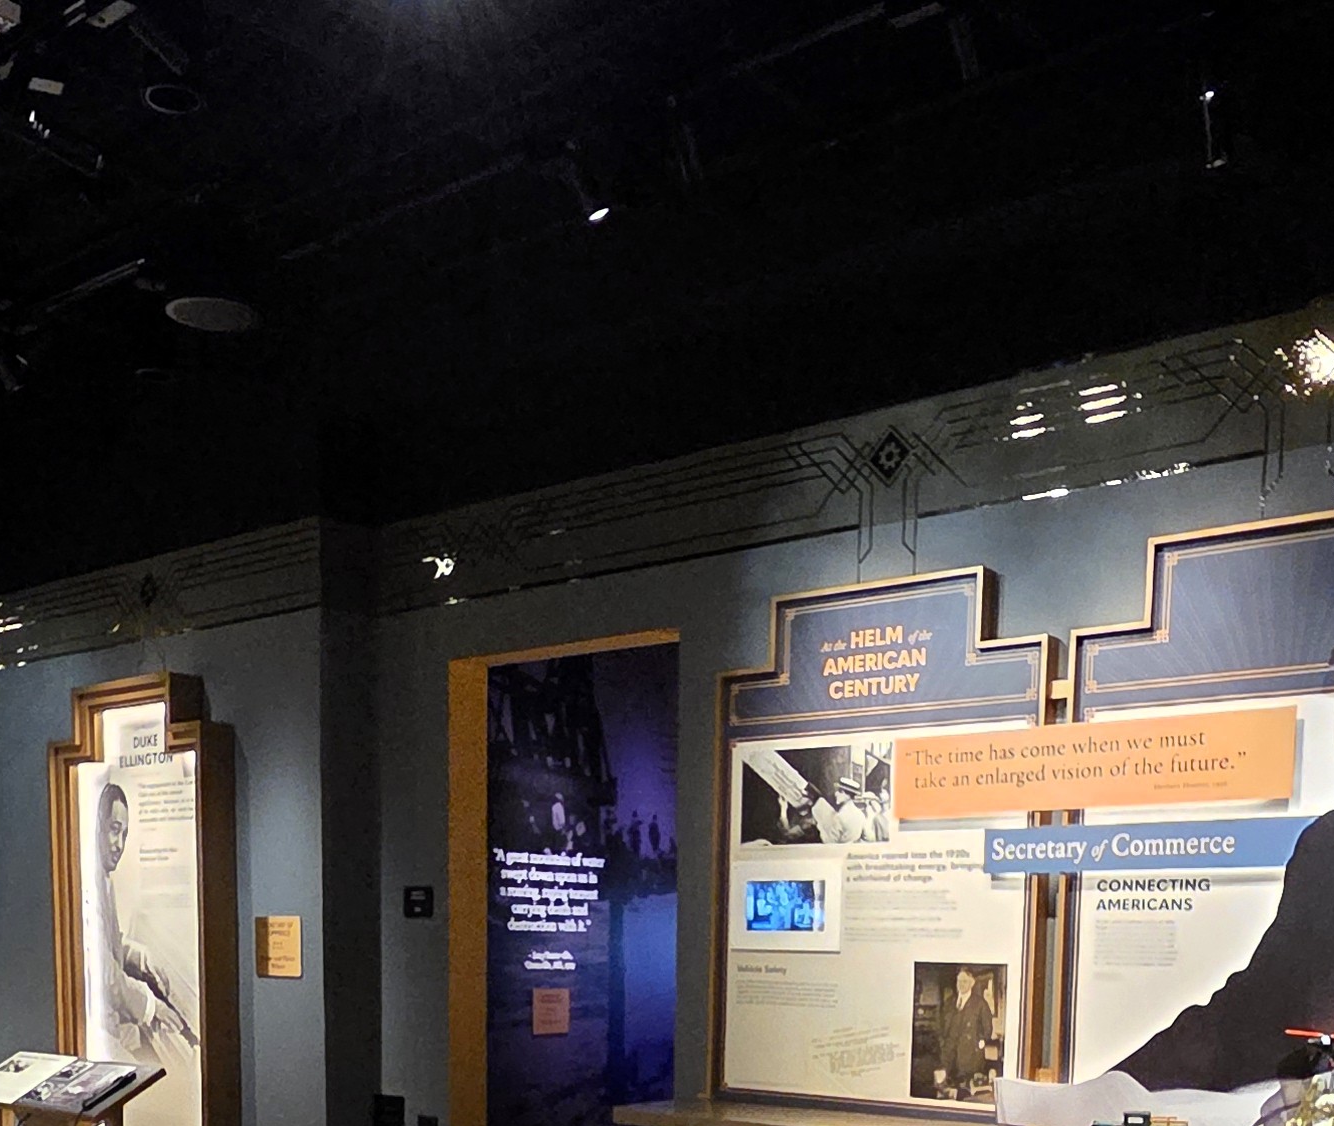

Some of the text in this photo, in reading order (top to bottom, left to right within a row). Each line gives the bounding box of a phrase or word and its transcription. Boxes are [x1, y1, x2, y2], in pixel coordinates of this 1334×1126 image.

[820, 625, 933, 653] At the HELM of the
[823, 647, 927, 676] AMERICAN
[829, 672, 920, 700] CENTURY
[133, 734, 158, 749] DUKE
[948, 749, 984, 764] time
[989, 743, 1015, 761] has
[1020, 745, 1066, 760] come
[1072, 736, 1120, 755] when
[1127, 738, 1153, 751] we
[1159, 731, 1207, 749] must
[119, 751, 173, 769] ELLINGTON
[914, 770, 947, 790] take
[952, 773, 970, 787] an
[976, 765, 1046, 789] enlarged
[1052, 764, 1103, 784] vision
[1109, 758, 1130, 777] of
[1134, 757, 1163, 775] the
[991, 832, 1236, 865] Secretary of Commerce
[1096, 878, 1211, 892] CONNECTING
[1096, 898, 1194, 911] AMERICANS
